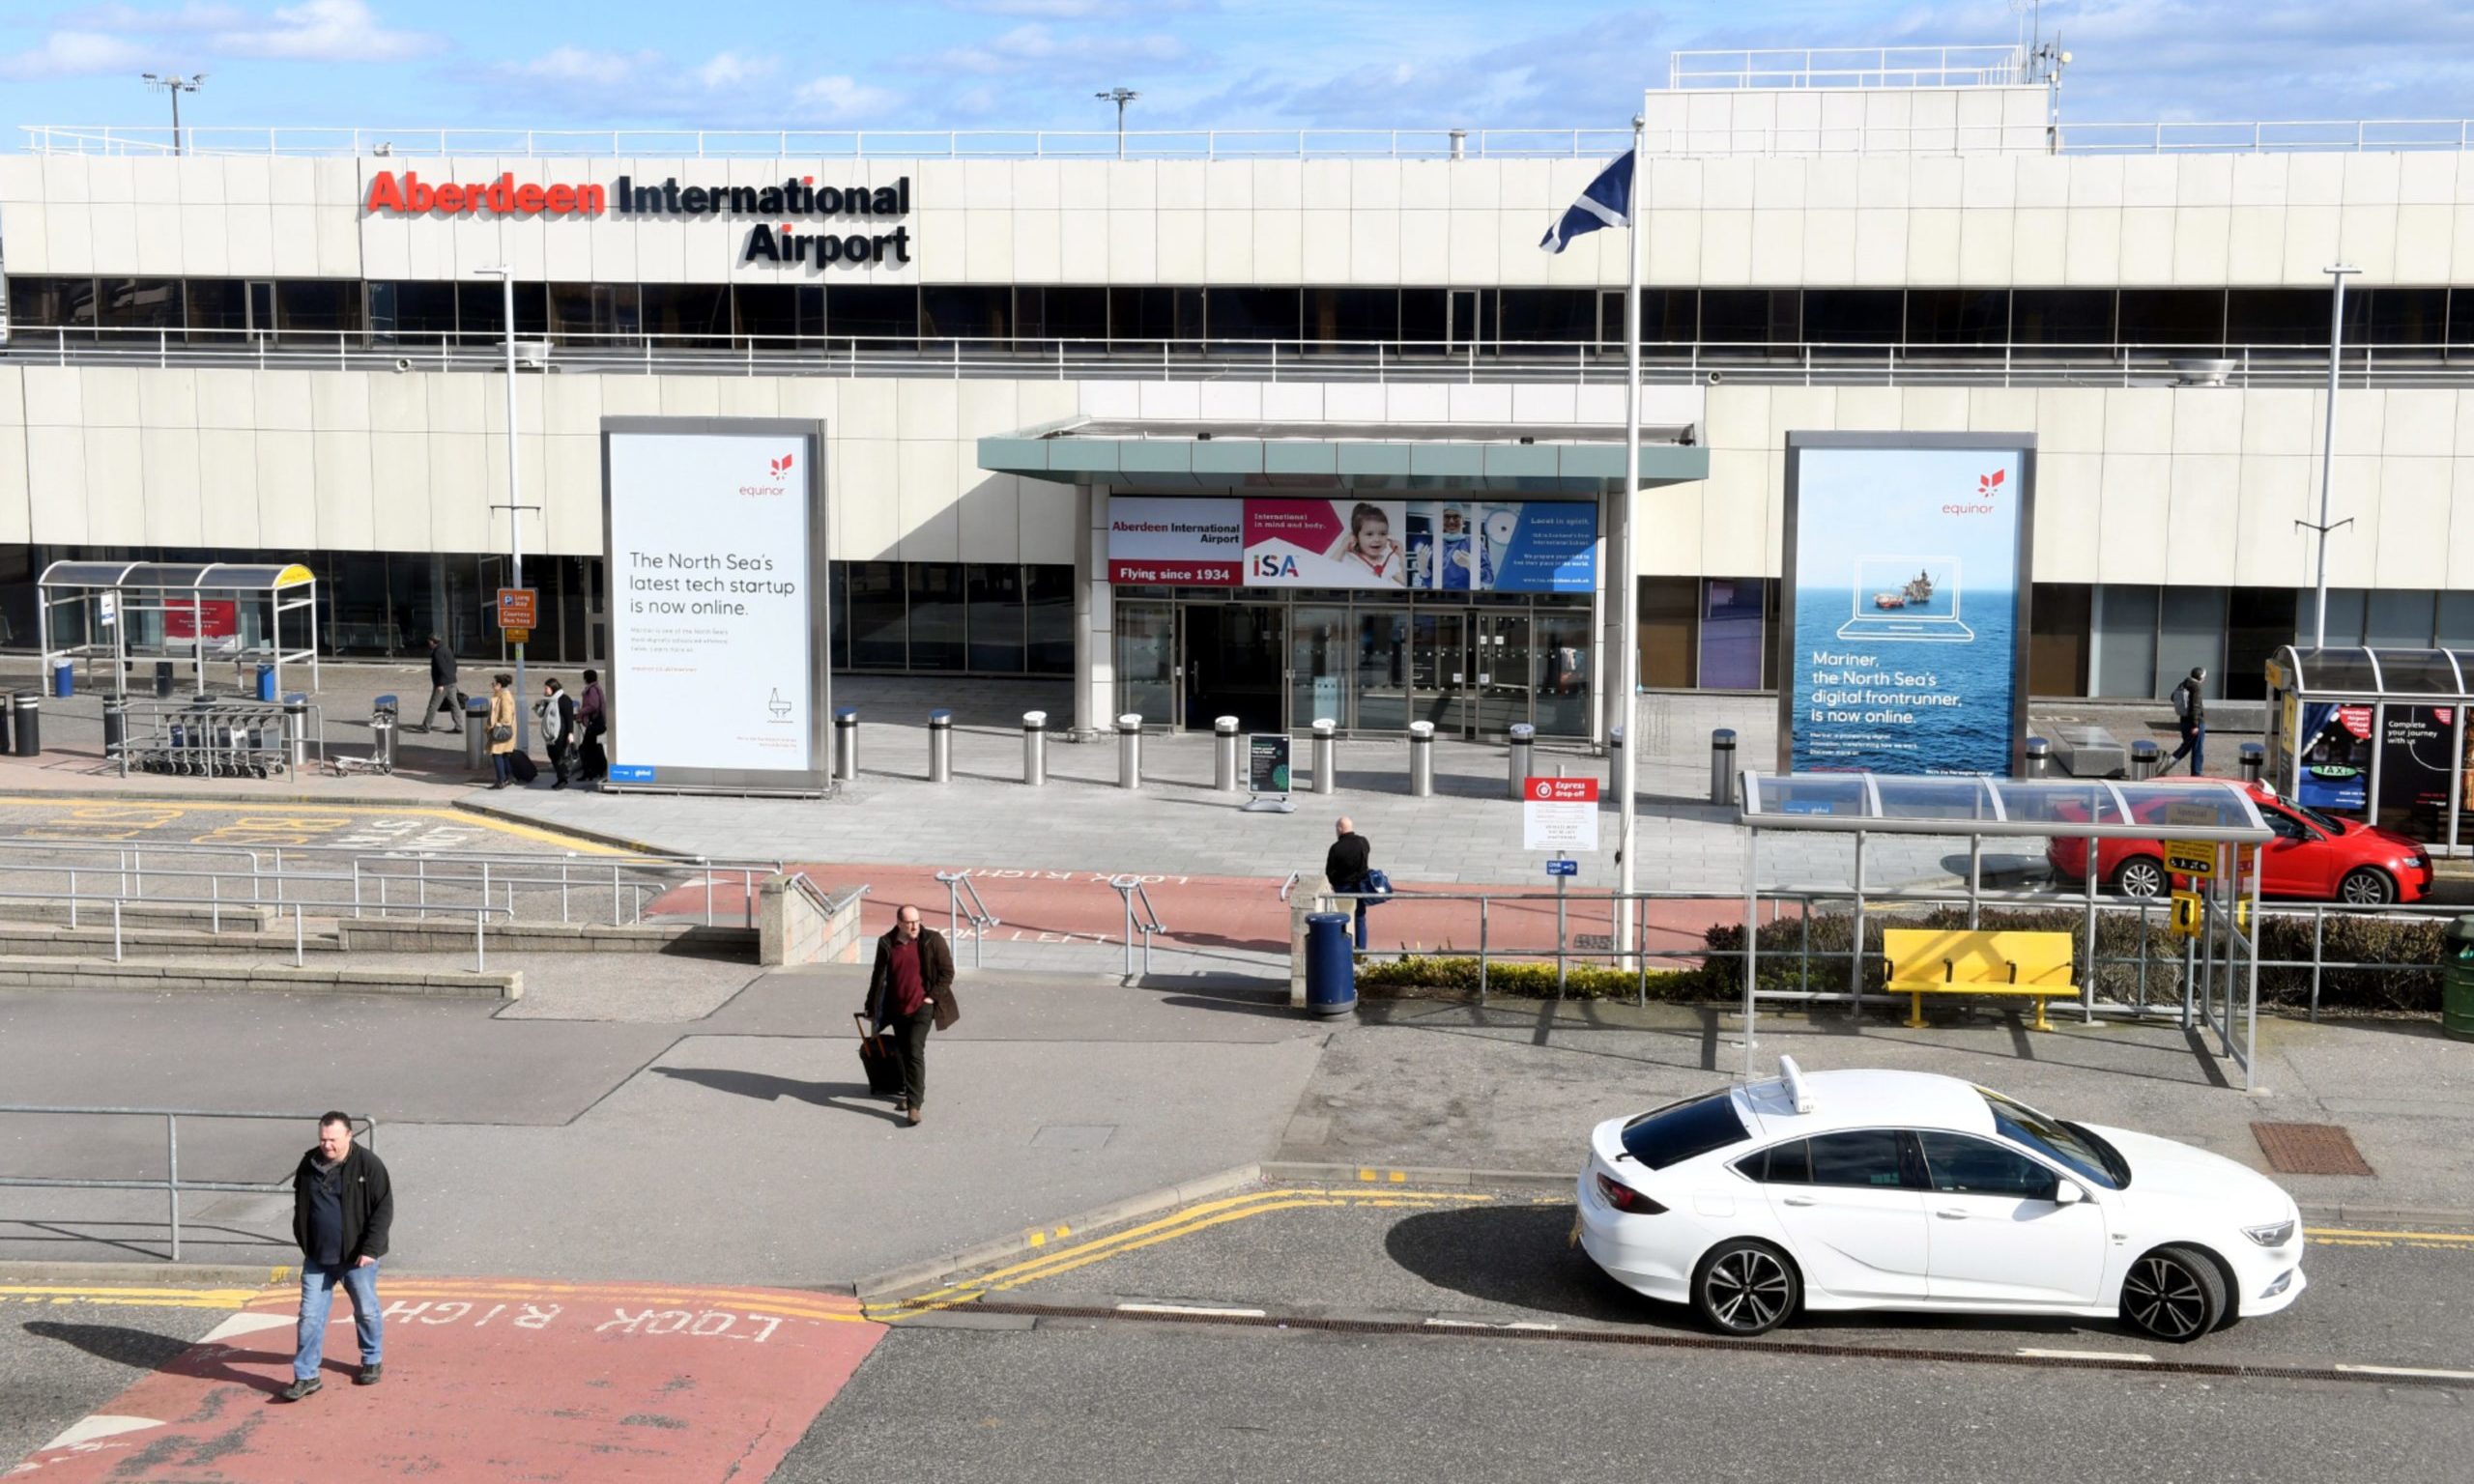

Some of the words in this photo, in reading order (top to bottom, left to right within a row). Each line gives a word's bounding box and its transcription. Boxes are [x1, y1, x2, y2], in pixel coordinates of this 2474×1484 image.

[366, 170, 605, 214] Aberdeen
[618, 176, 909, 215] International
[744, 223, 910, 269] Airport
[738, 485, 785, 499] equinor
[1942, 502, 1994, 516] equinor
[1112, 522, 1168, 532] Aberdeen
[1170, 523, 1240, 534] International
[1200, 533, 1240, 545] Airport
[630, 552, 663, 568] The
[669, 554, 721, 569] North
[726, 554, 773, 571] Sea's
[1120, 567, 1156, 581] Flying
[1160, 568, 1192, 580] since
[1196, 569, 1229, 580] 1934
[630, 575, 679, 591] latest
[686, 577, 724, 592] tech
[730, 579, 795, 597] startup
[630, 598, 644, 614] is
[649, 601, 685, 614] now
[691, 600, 749, 615] online.
[1813, 651, 1880, 668] Mariner,
[1813, 671, 1838, 684] the
[1843, 671, 1889, 686] North
[1894, 671, 1937, 687] Sea's
[1811, 691, 1861, 707] digital
[1811, 708, 1823, 722] is
[1828, 711, 1861, 723] now
[1865, 709, 1916, 724] online.
[2407, 729, 2437, 738] journey
[1011, 930, 1116, 945] LEFT
[596, 1307, 782, 1343] LOOK
